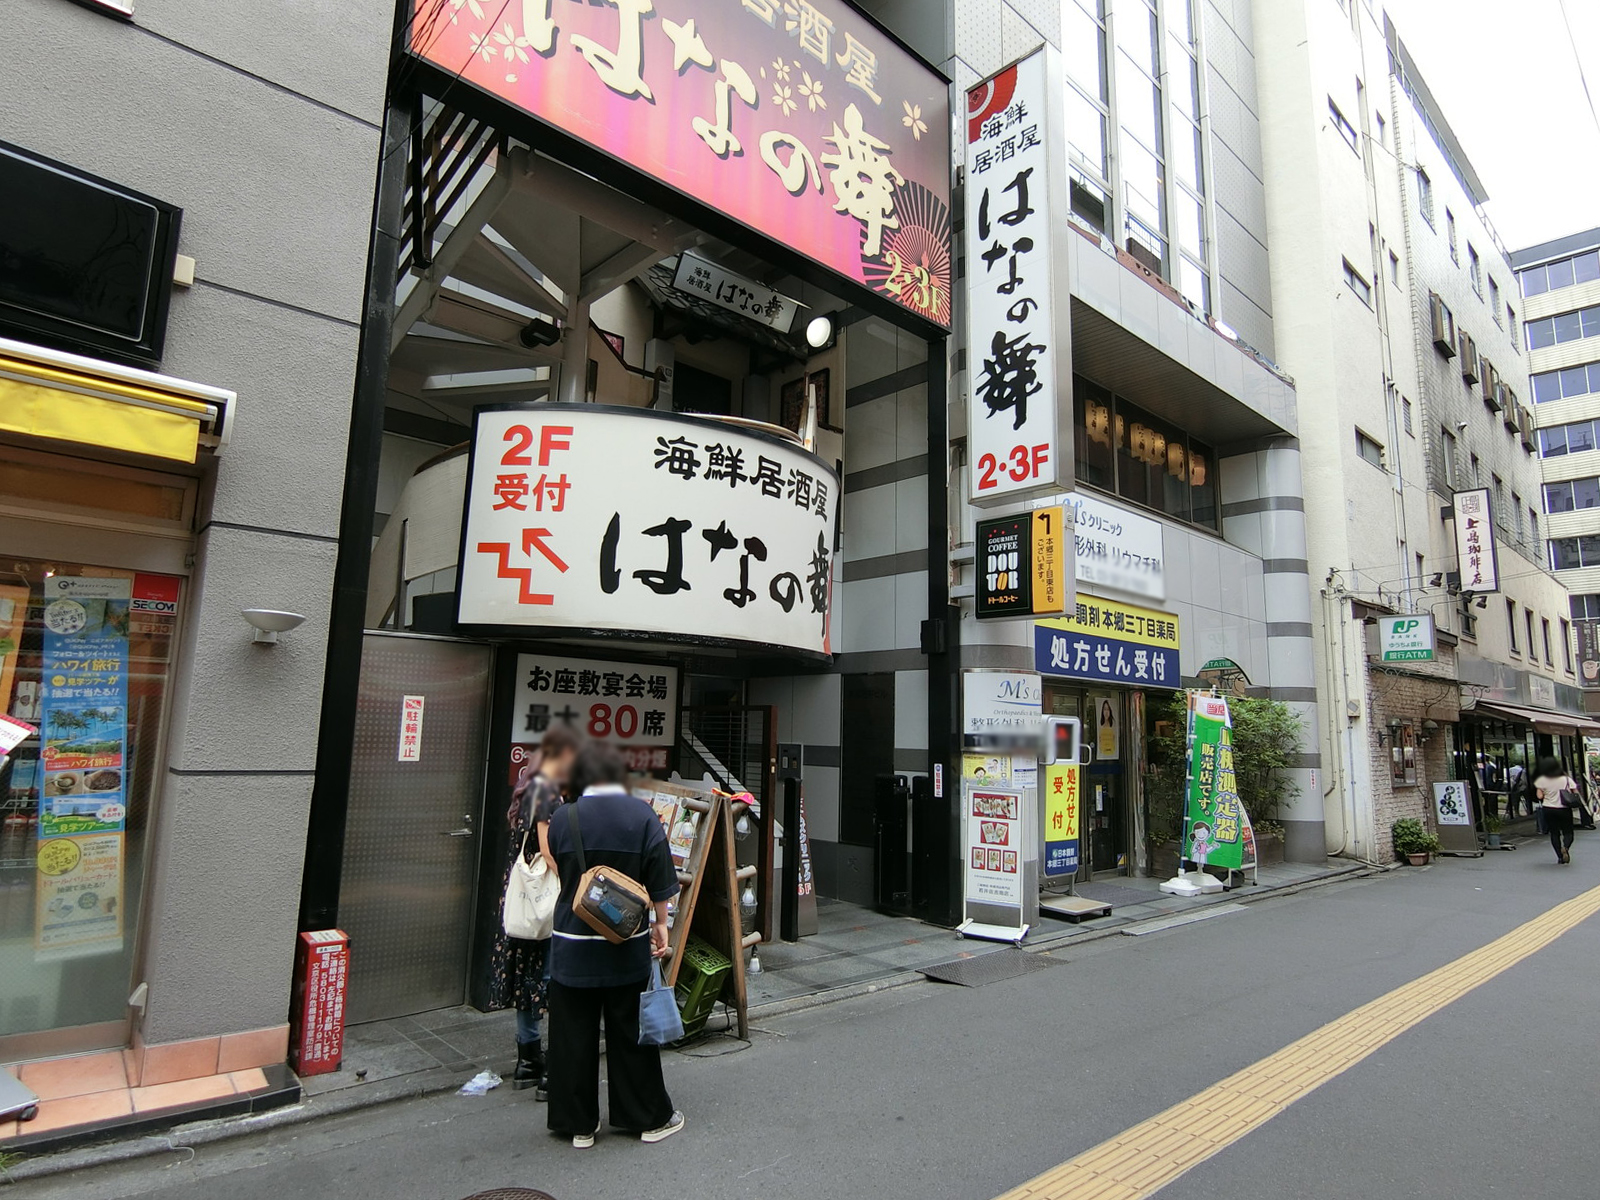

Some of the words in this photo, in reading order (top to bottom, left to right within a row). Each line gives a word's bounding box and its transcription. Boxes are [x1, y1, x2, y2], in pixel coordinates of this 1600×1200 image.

[522, 0, 905, 257] はなの舞
[980, 100, 1029, 141] 海鮮
[971, 124, 1042, 175] 居酒屋
[686, 275, 713, 294] 居酒屋
[694, 267, 711, 281] 海鮮
[715, 280, 784, 325] はなの舞
[975, 167, 1047, 431] はなの舞
[500, 424, 574, 466] 2F
[492, 473, 571, 512] 受付
[654, 435, 828, 523] 海鮮居酒屋
[988, 534, 1019, 544] GOURMET
[988, 541, 1019, 553] COFFEE
[1465, 518, 1482, 586] 上島珈琲店
[600, 511, 830, 637] はなの舞
[986, 571, 1018, 591] TOR
[987, 552, 1018, 573] DOU
[133, 600, 174, 612] SECOM
[987, 595, 1019, 604] ドトールコーヒー
[1102, 609, 1175, 641] 本郷三丁目薬局
[1392, 620, 1419, 634] JP
[52, 659, 121, 671] ハワイ旅行
[1050, 635, 1166, 681] 処方せん受付
[1389, 651, 1427, 659] 銀行ATM
[527, 666, 667, 700] お座敷宴会場
[403, 711, 419, 758] 駐輪禁止
[70, 757, 113, 768] ハワイ旅行
[1198, 743, 1215, 816] 販売店です。
[1052, 776, 1063, 829] 受付
[1066, 768, 1076, 836] 処方せん
